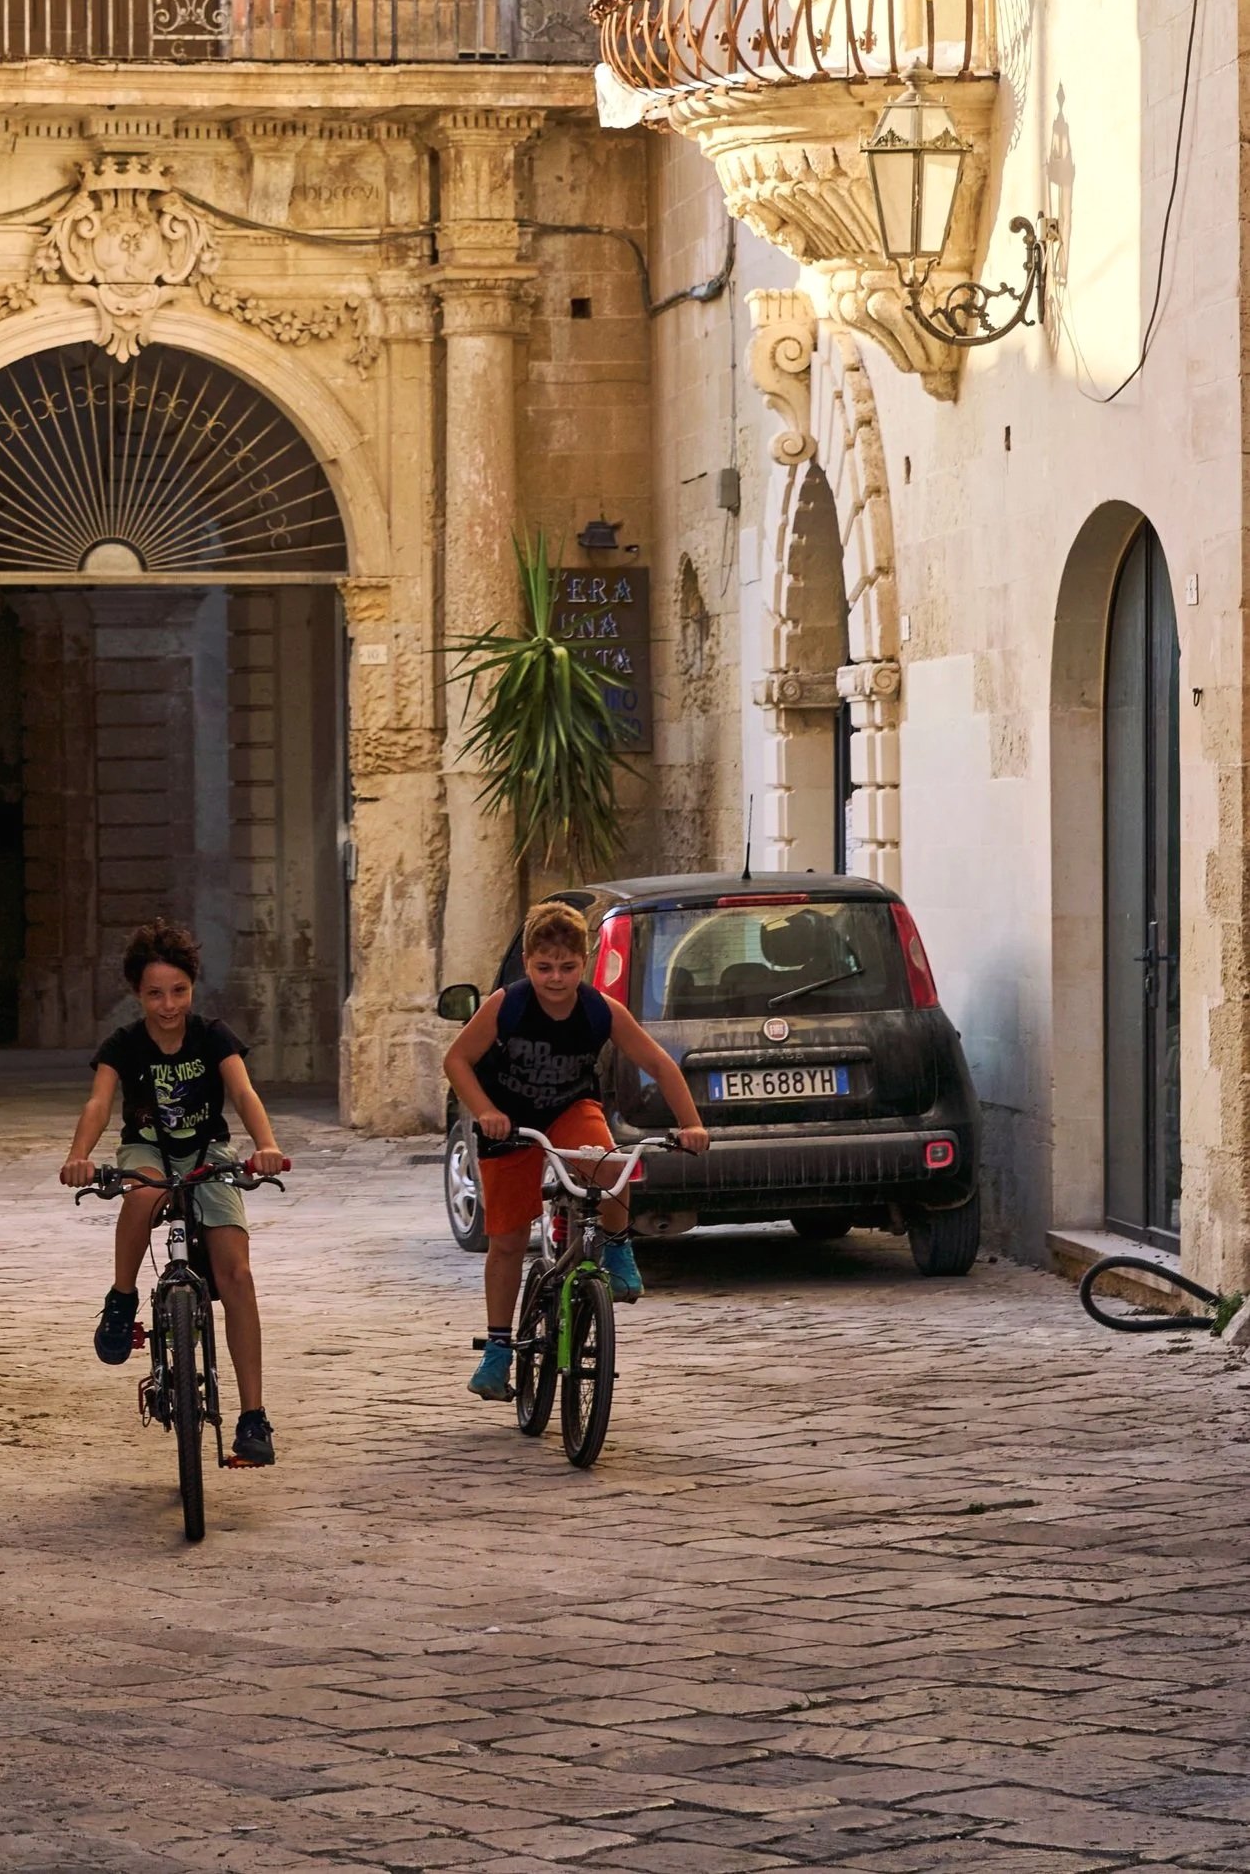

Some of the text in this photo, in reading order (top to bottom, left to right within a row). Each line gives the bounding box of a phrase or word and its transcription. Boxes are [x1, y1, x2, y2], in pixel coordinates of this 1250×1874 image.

[174, 1058, 206, 1082] VIBES
[726, 1069, 834, 1097] ER 688YH
